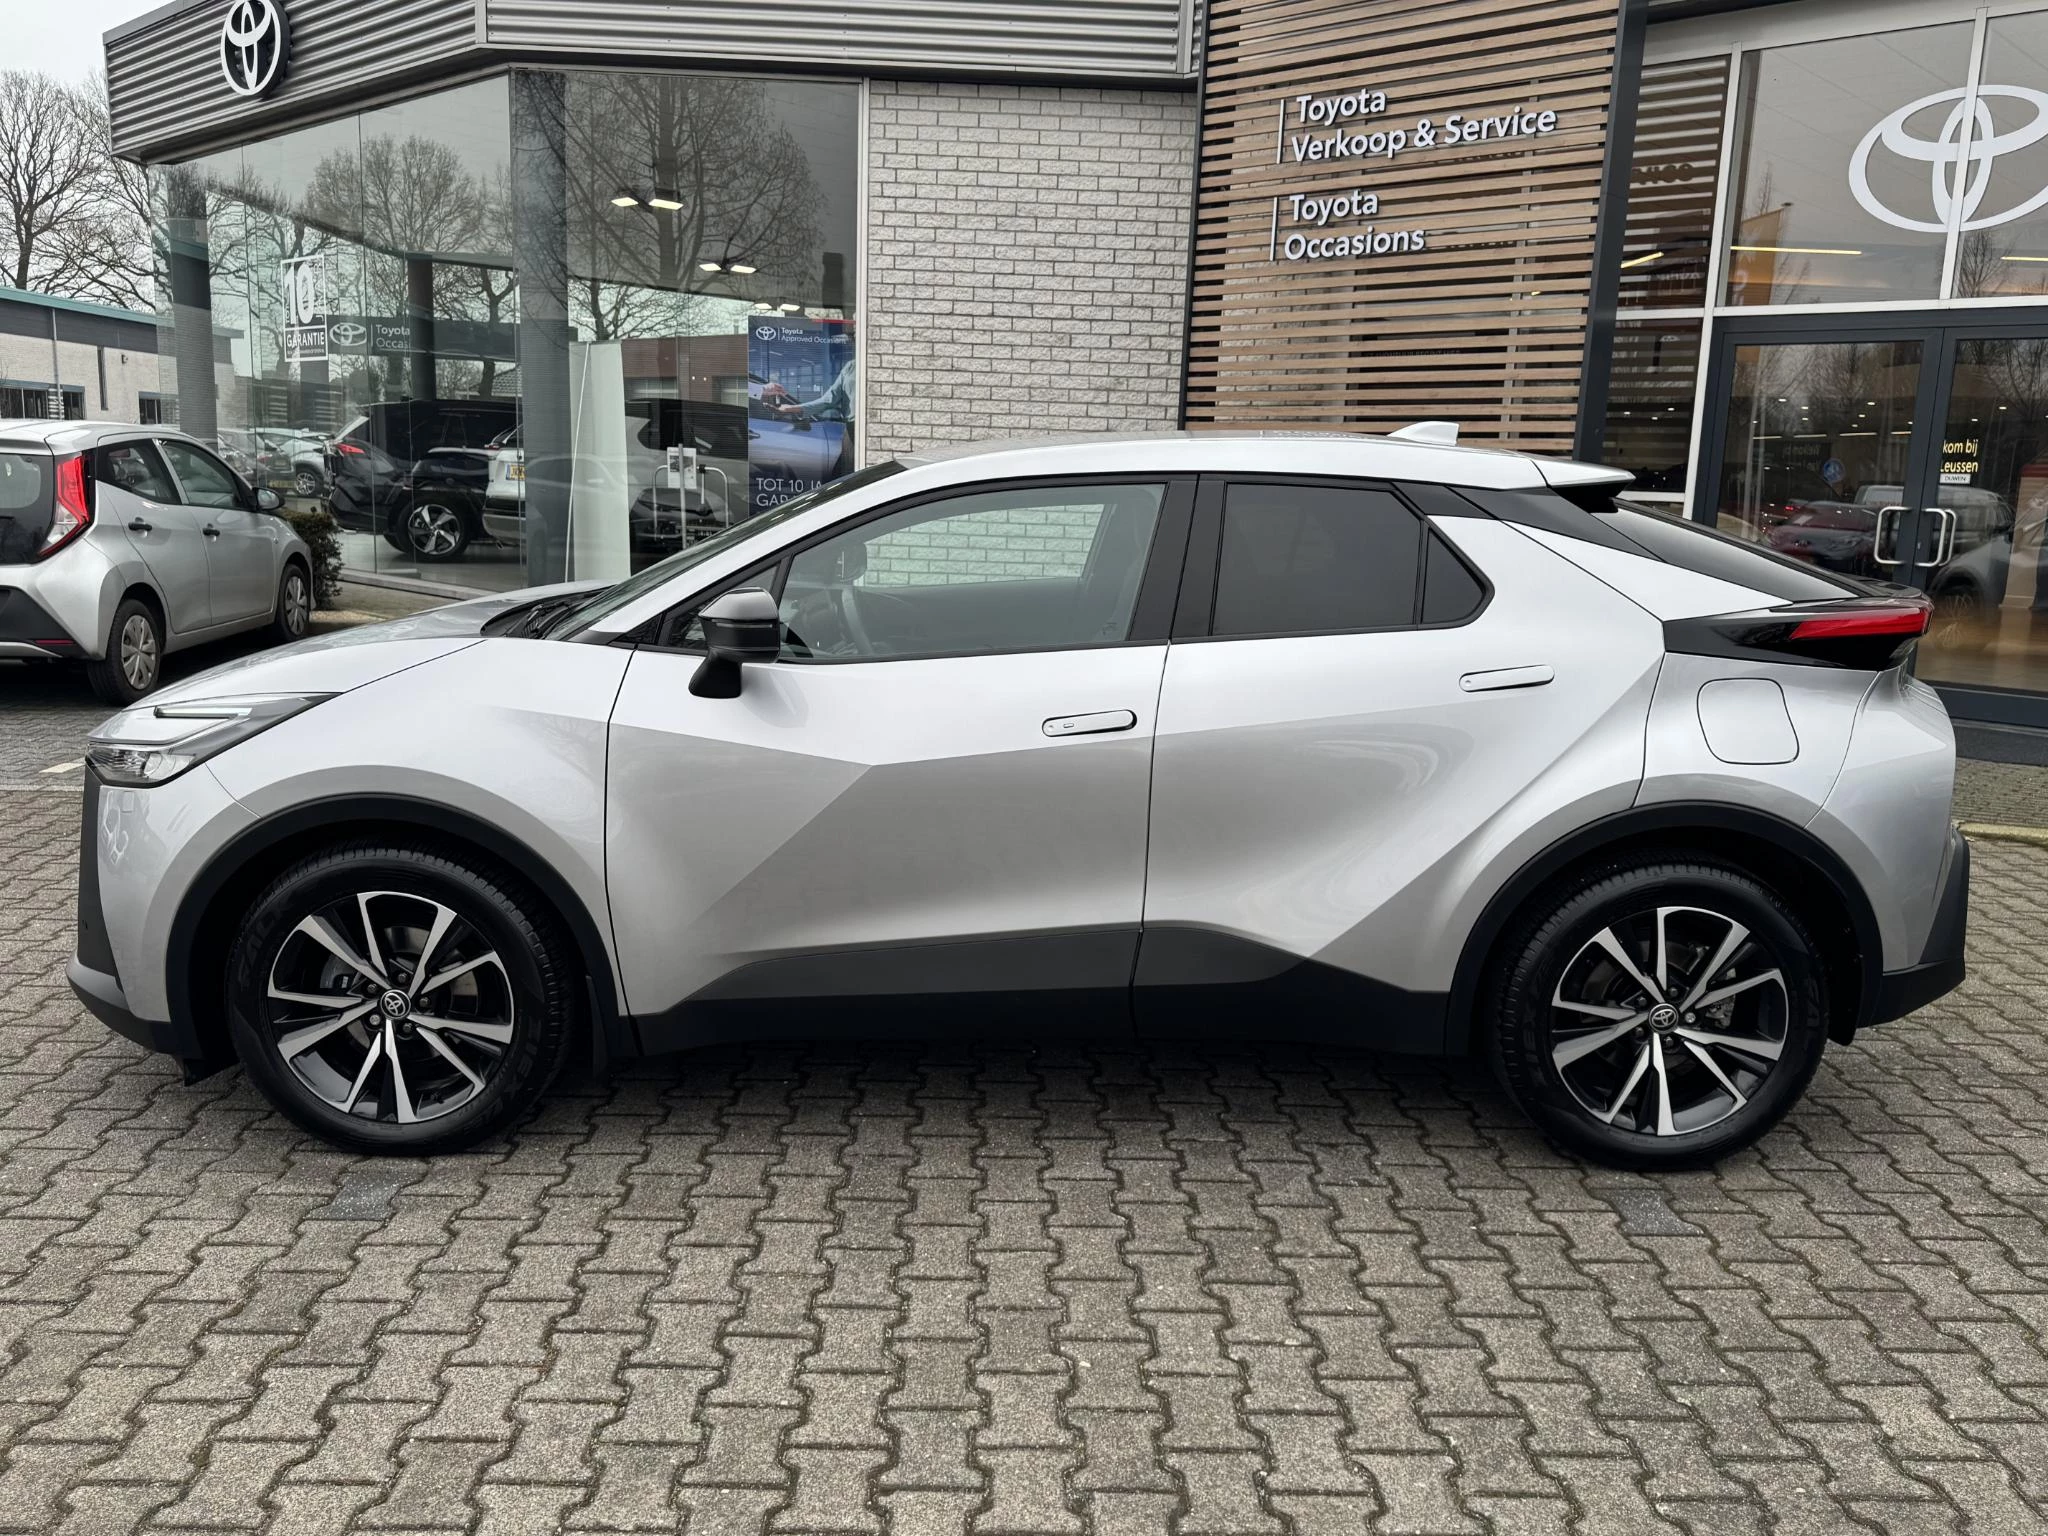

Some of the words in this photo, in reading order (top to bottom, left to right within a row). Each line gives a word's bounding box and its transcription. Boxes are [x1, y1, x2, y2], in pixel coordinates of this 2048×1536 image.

[1296, 88, 1387, 126] Toyota
[1291, 128, 1407, 162] Verkoop
[1413, 118, 1437, 149] &
[1444, 105, 1558, 145] Service
[1289, 189, 1379, 226] Toyota
[1284, 225, 1426, 261] Occasions
[284, 262, 315, 325] 10
[286, 331, 325, 348] GARANTIE
[375, 324, 411, 338] Toyota
[781, 327, 804, 336] Toyota
[781, 335, 813, 344] Approved
[1942, 440, 1964, 454] kom
[1965, 438, 1979, 457] bij
[755, 478, 785, 492] TOT
[788, 480, 804, 493] 10
[756, 493, 797, 507] GAR
